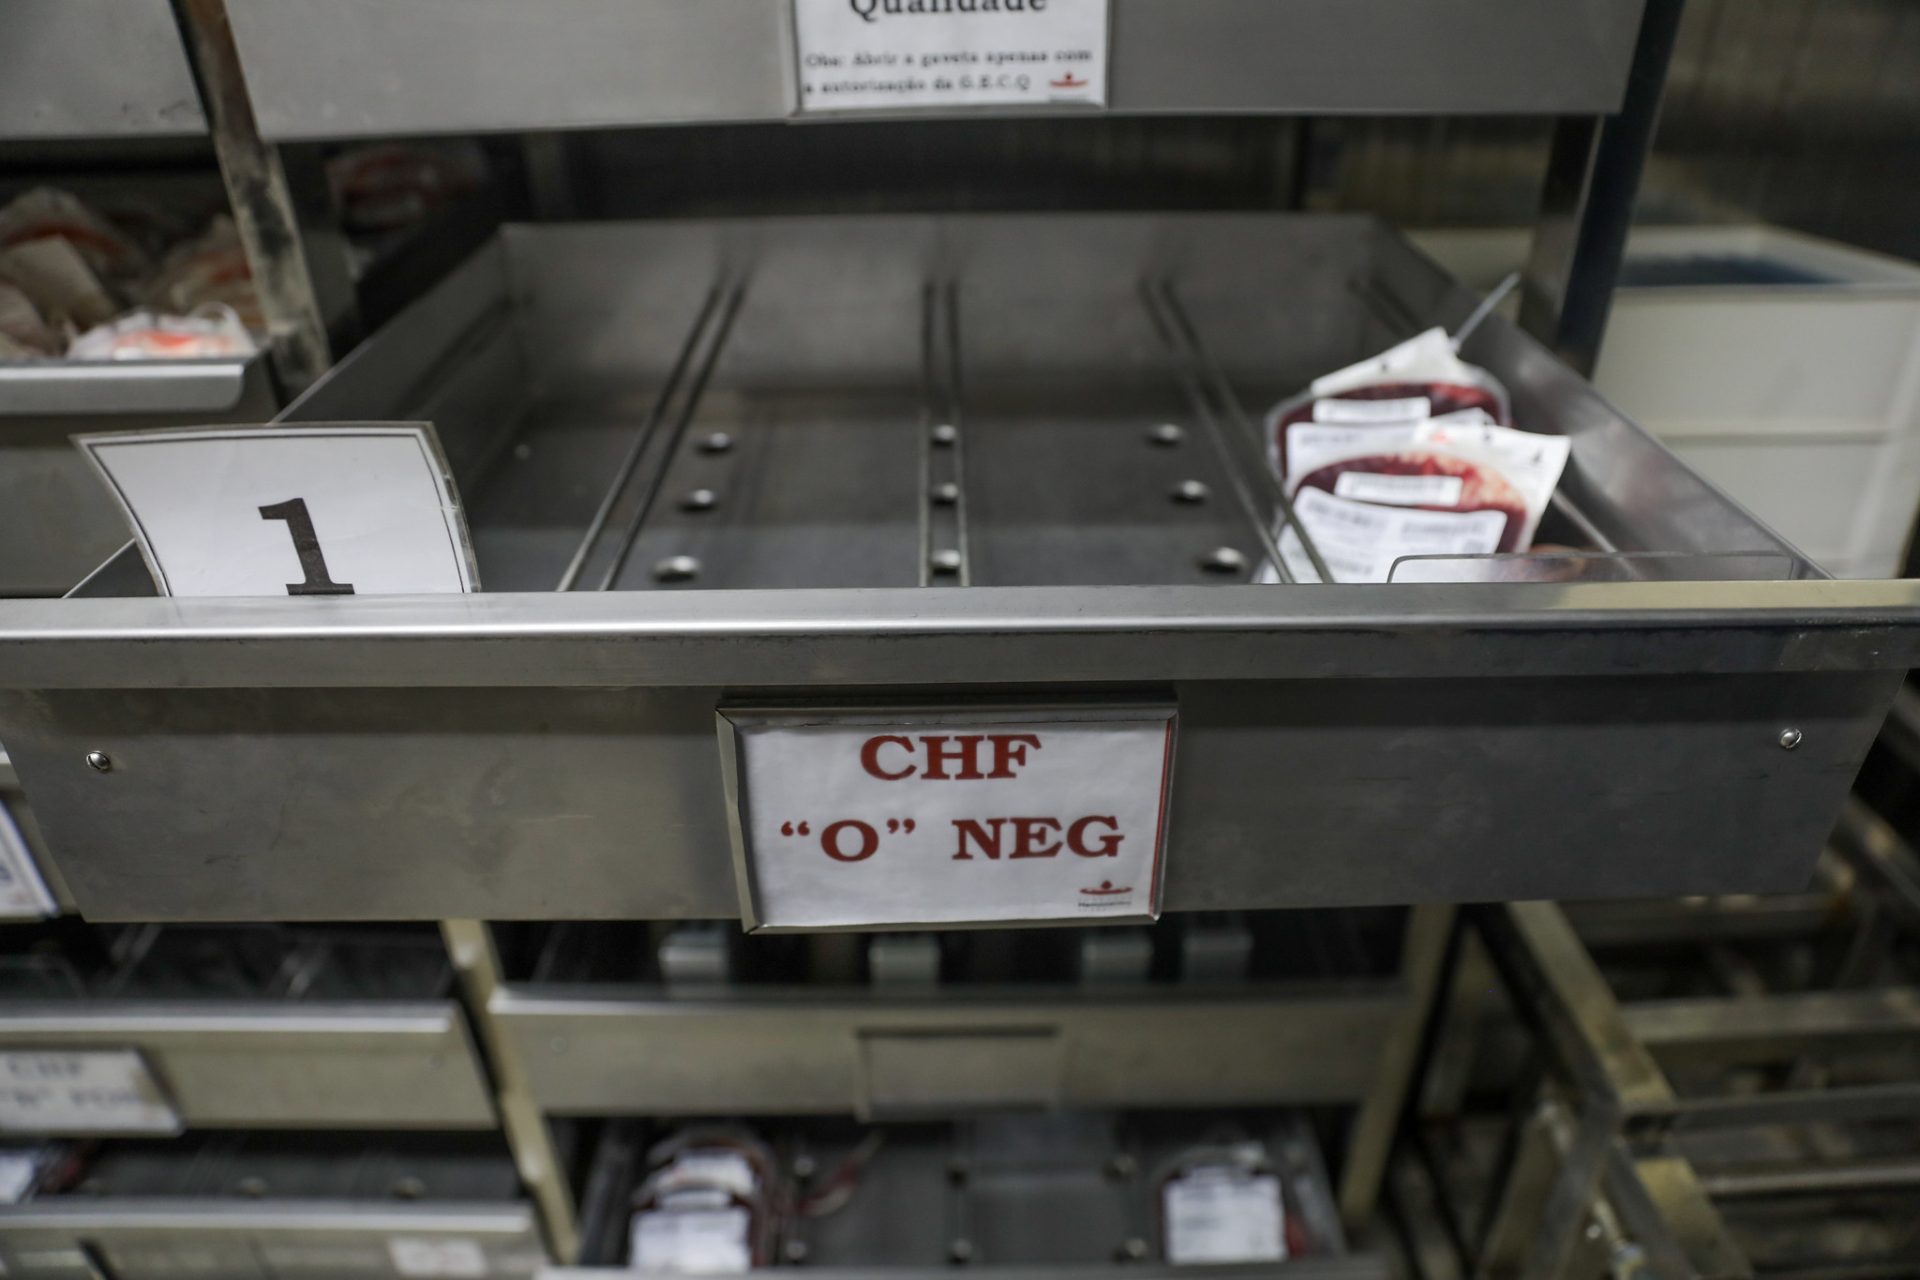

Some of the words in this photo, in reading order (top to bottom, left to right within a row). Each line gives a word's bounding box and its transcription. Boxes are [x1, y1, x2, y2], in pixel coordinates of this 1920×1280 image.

[921, 51, 977, 69] gaveta
[986, 51, 1047, 67] apenas
[1055, 50, 1092, 62] com
[258, 497, 355, 595] 1
[860, 733, 1042, 781] CHF
[951, 814, 1125, 861] NEG
